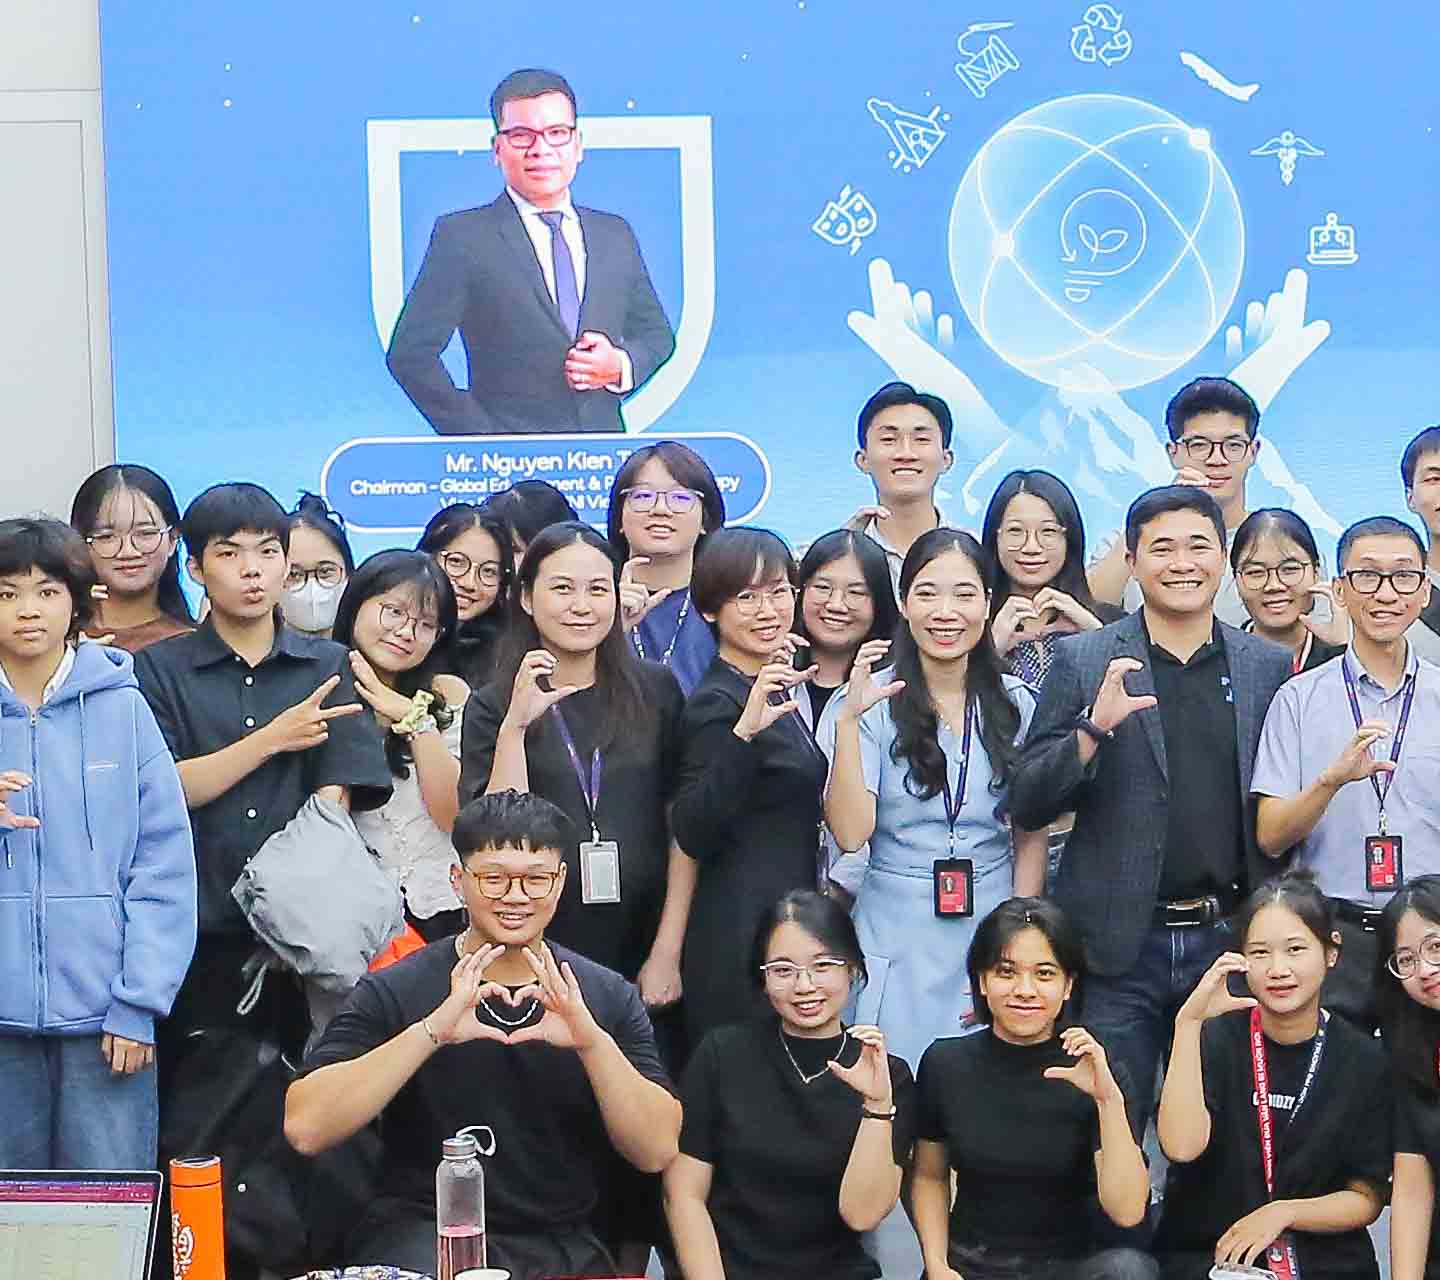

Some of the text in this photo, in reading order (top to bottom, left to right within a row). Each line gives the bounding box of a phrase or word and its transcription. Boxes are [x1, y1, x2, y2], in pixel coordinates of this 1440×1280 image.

[445, 452, 478, 473] Mr.
[481, 452, 563, 477] Nguyen
[566, 450, 613, 471] Kien
[350, 479, 428, 495] Chairman
[439, 477, 487, 494] Global
[588, 475, 602, 492] &
